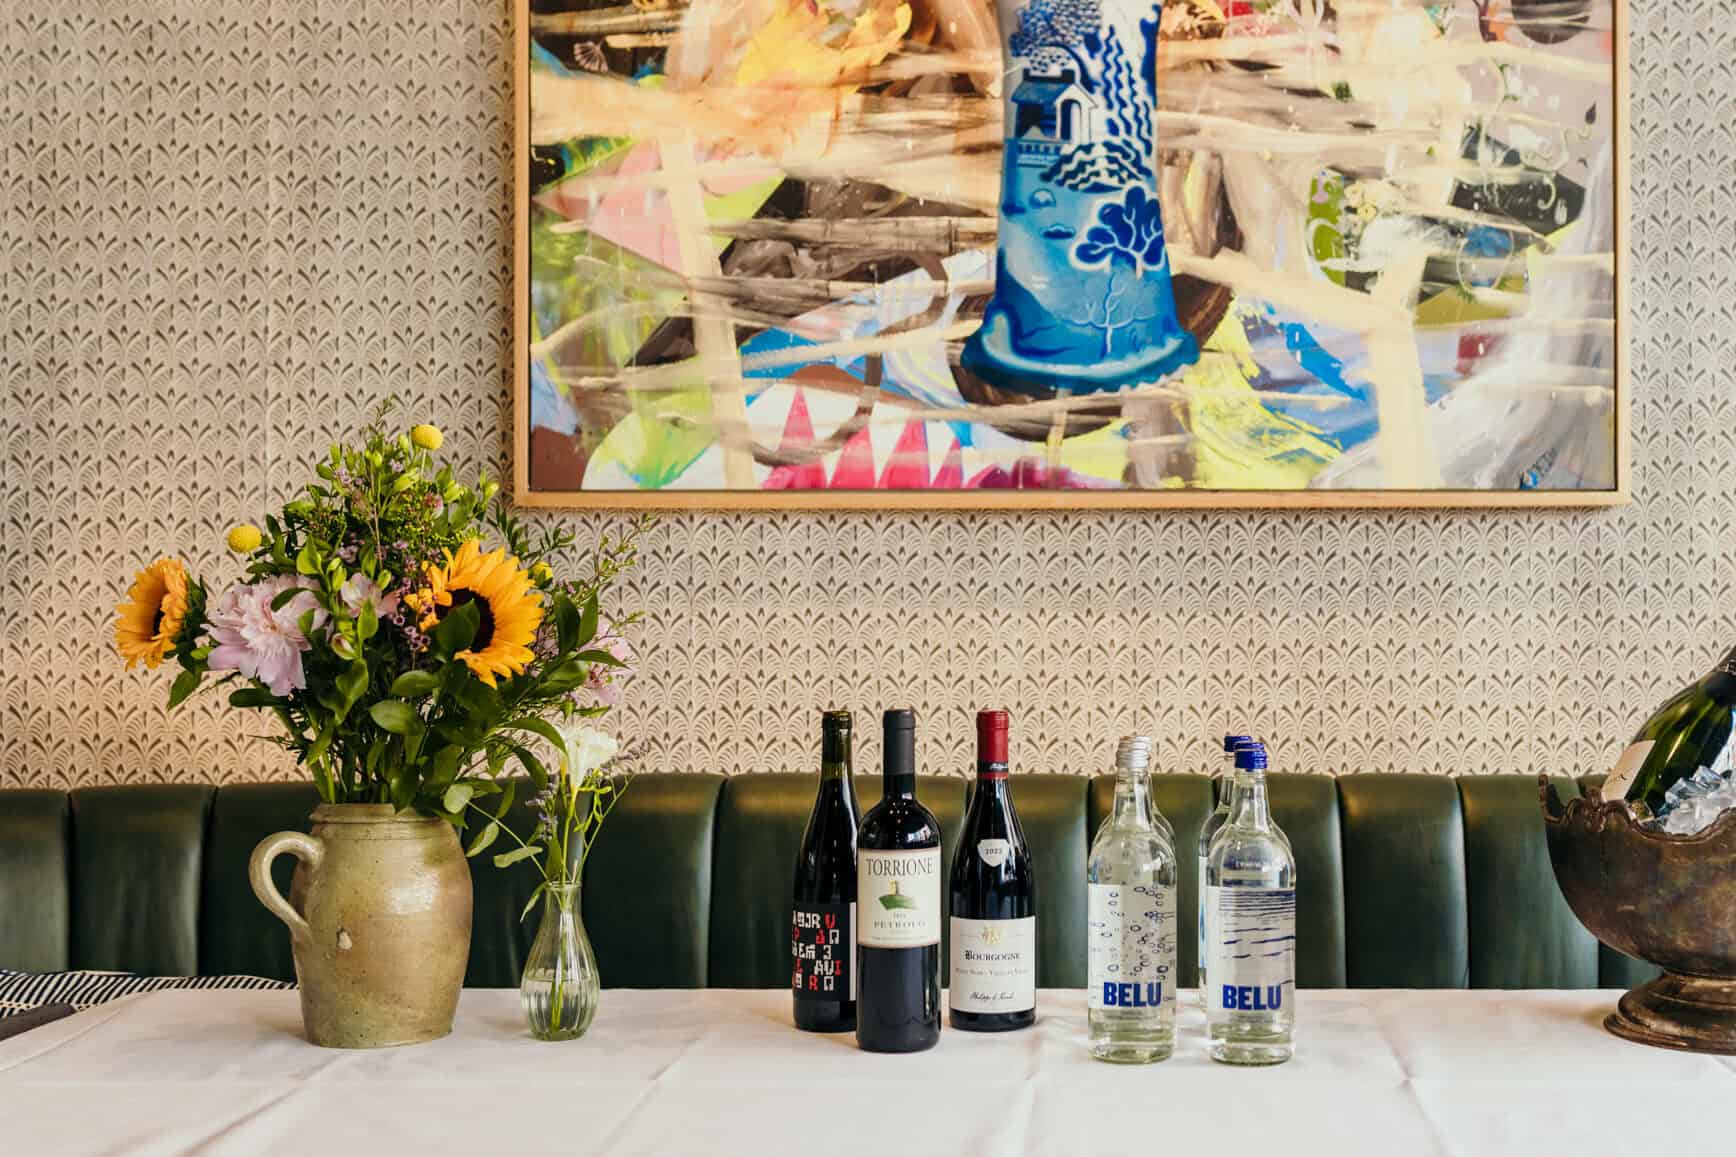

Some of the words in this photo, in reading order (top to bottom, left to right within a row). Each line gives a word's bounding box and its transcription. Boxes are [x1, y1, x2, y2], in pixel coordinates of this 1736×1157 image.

[865, 857, 933, 876] TORRIONE
[1103, 981, 1162, 1007] BELU
[1222, 983, 1281, 1011] BELU
